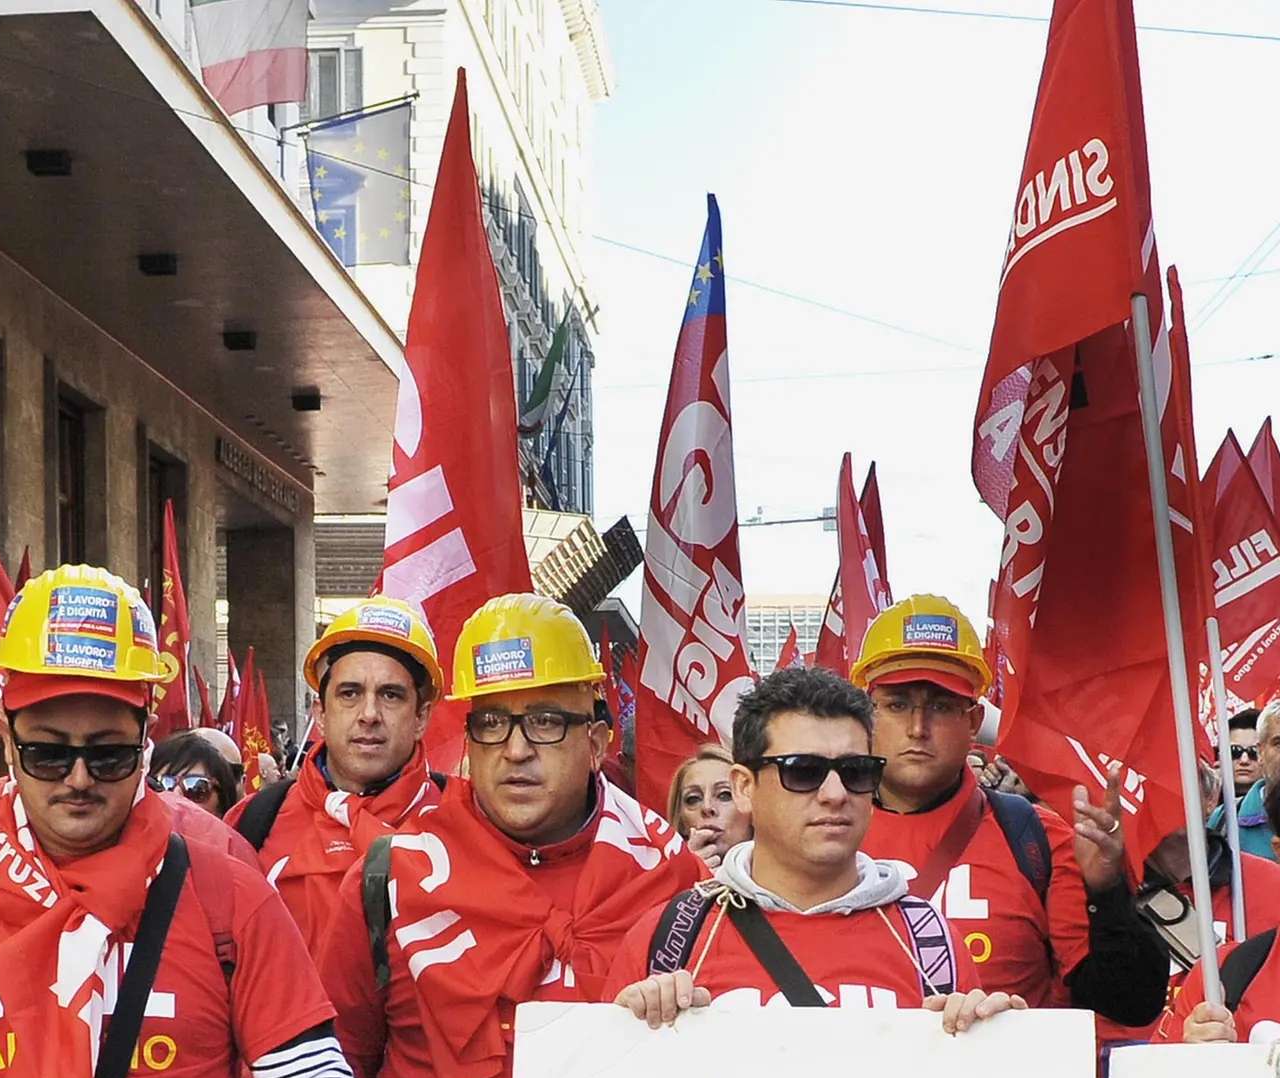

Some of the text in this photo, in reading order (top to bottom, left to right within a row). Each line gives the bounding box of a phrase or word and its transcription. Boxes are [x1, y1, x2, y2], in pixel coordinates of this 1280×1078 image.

[69, 595, 109, 607] LAVORO
[66, 643, 106, 657] LAVORO
[485, 650, 525, 663] LAVORO
